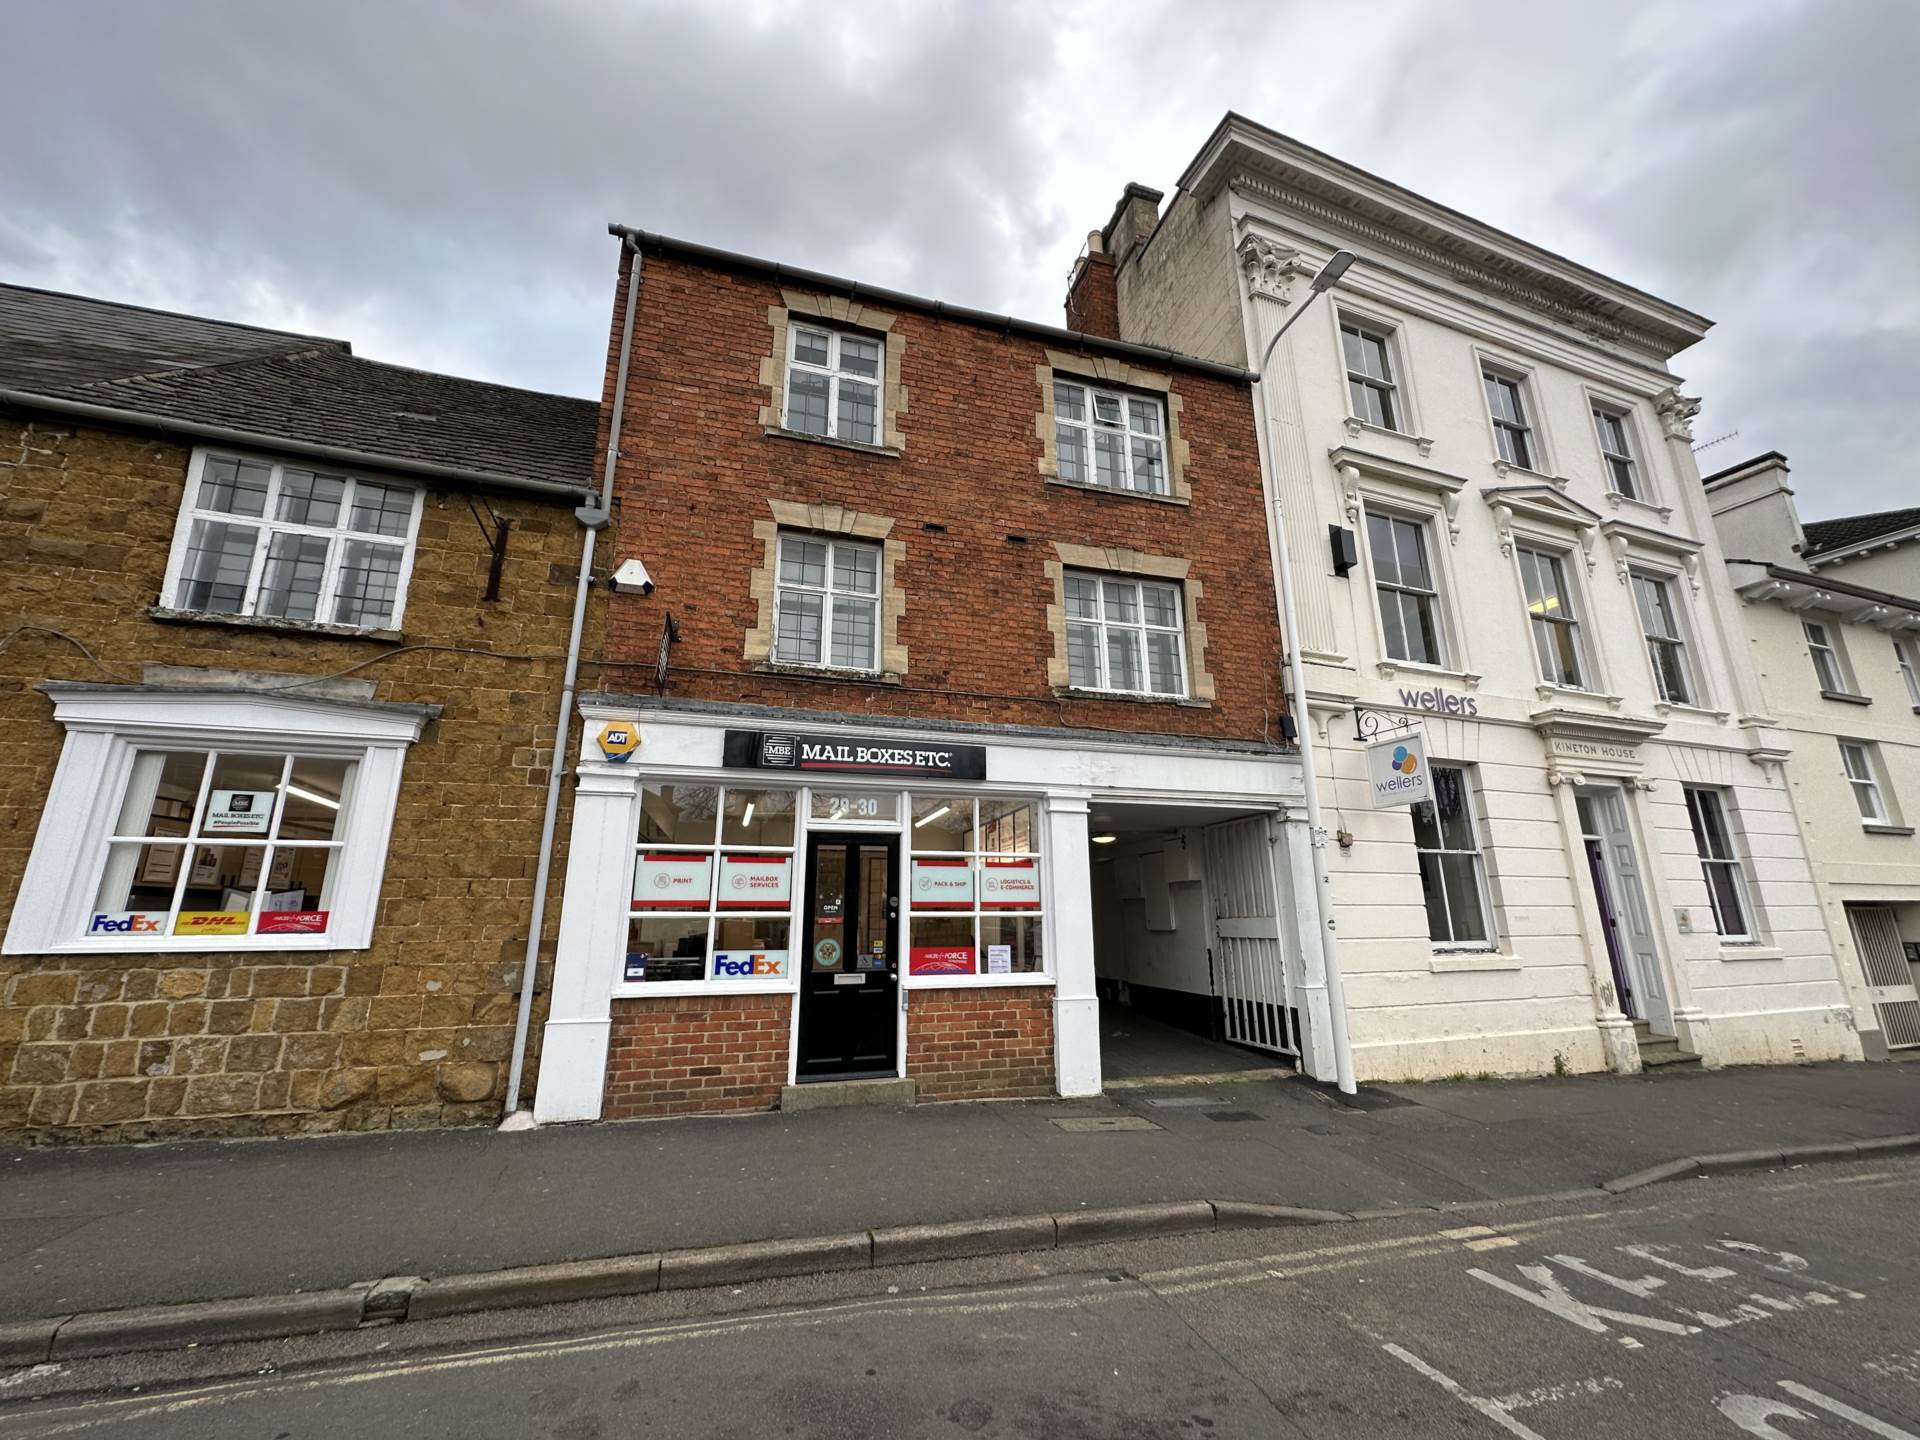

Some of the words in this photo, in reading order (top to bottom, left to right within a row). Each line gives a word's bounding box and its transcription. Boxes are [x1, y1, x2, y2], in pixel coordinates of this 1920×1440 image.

[1399, 687, 1478, 716] wellers
[607, 732, 628, 743] ADT
[768, 746, 791, 755] MBE
[801, 743, 854, 762] MAIL
[856, 747, 913, 765] BOXES
[1553, 742, 1597, 755] KINETON
[1600, 746, 1637, 759] HOUSE
[1375, 775, 1423, 793] wellers
[92, 914, 160, 932] FedEx
[192, 916, 236, 925] DHL
[714, 954, 782, 976] FedEx
